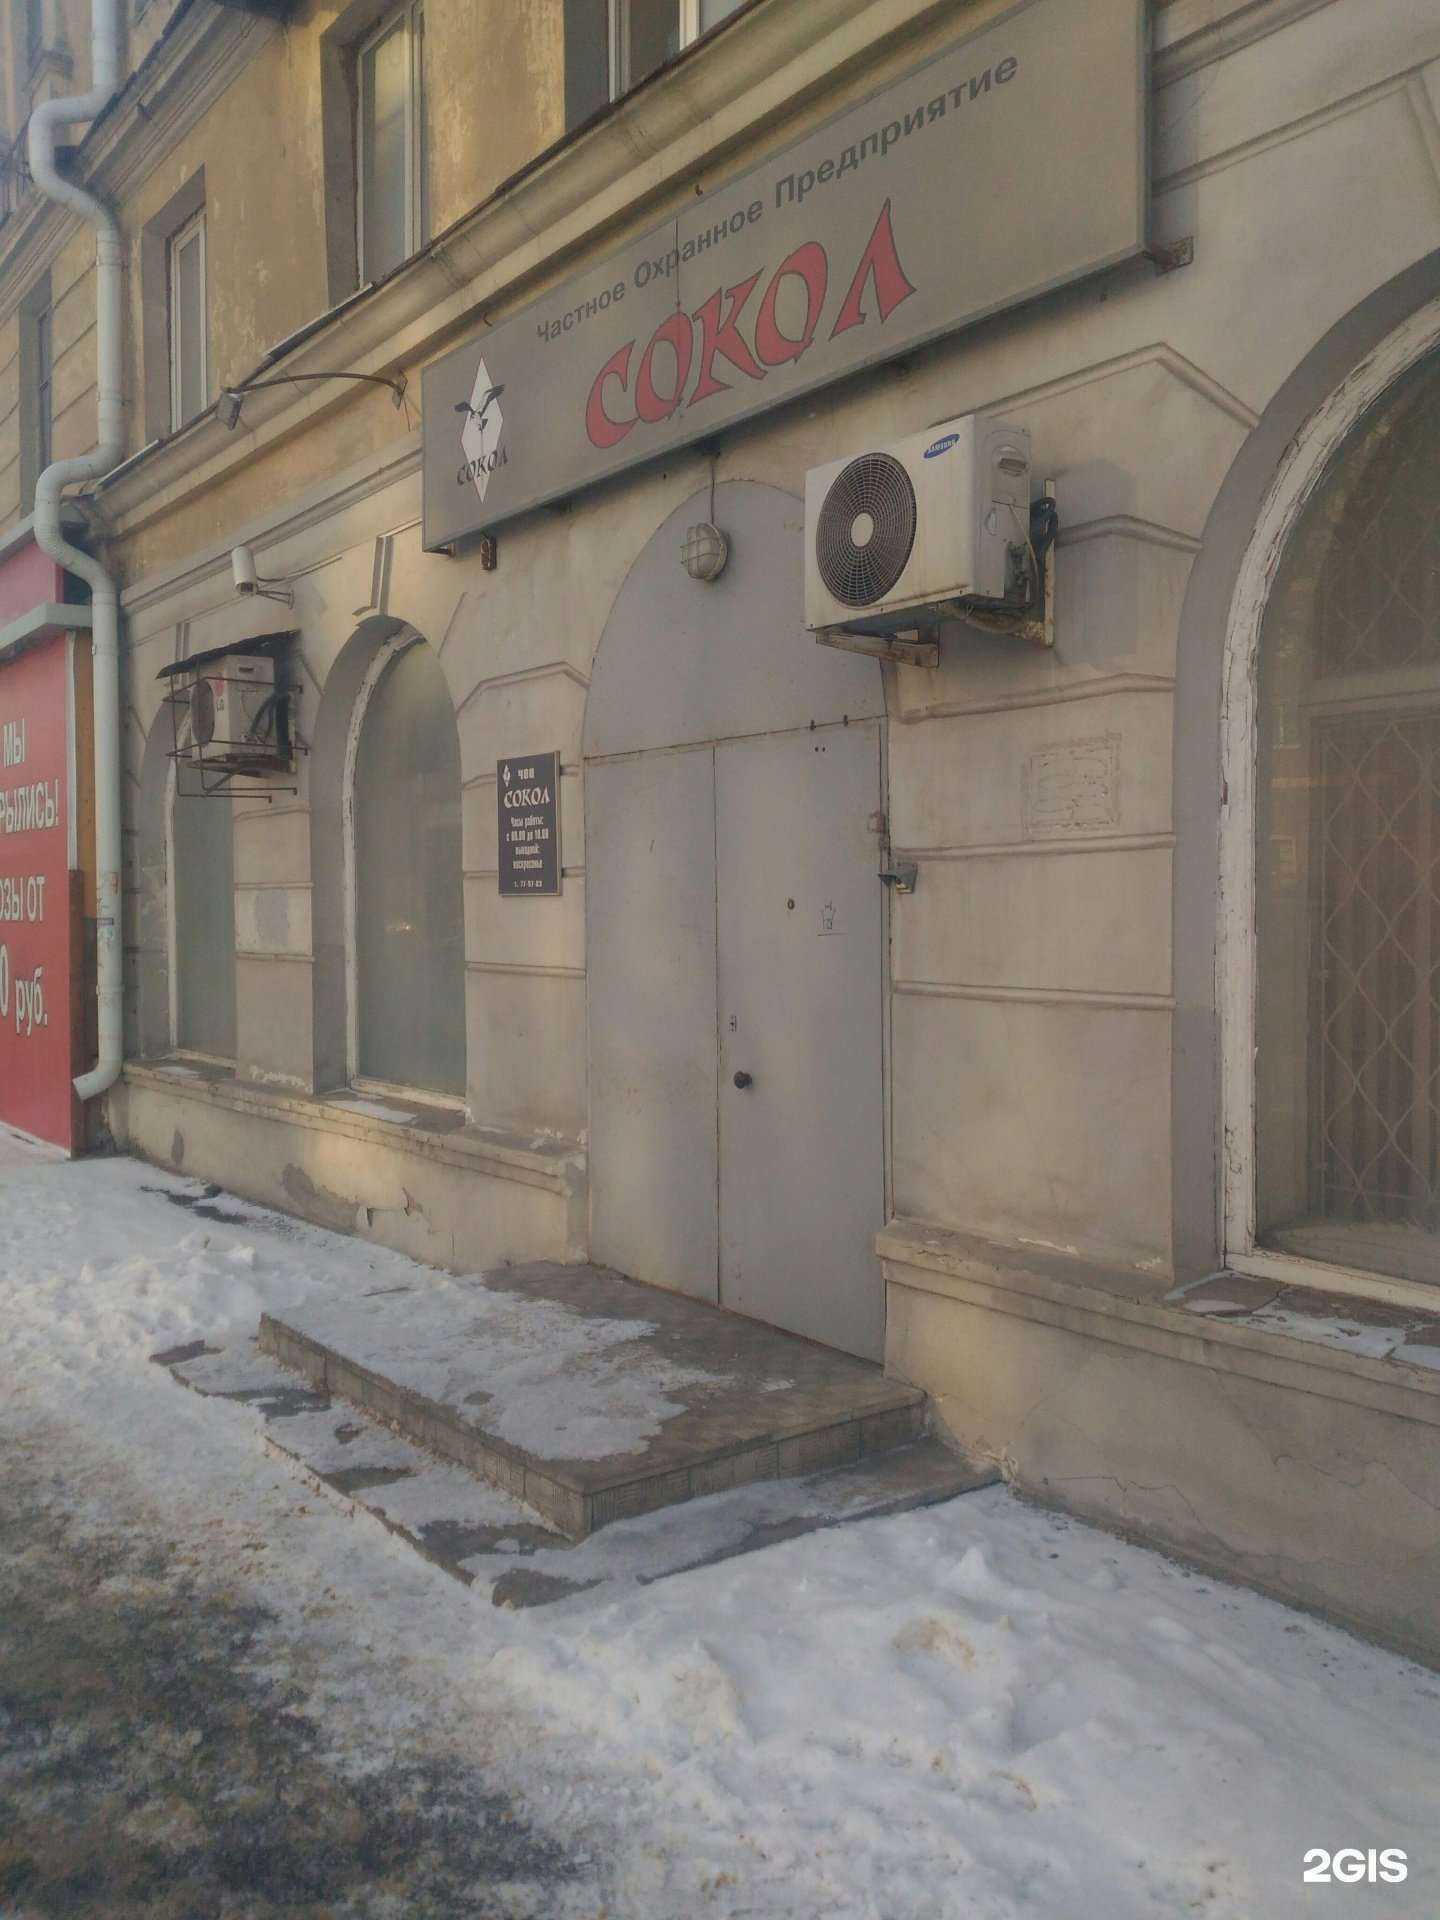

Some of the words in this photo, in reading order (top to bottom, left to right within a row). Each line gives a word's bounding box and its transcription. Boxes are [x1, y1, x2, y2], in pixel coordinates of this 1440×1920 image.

[536, 281, 626, 342] Частное
[633, 200, 763, 289] Охранное
[775, 56, 1018, 208] Предприятие
[585, 197, 917, 449] СОКОЛ
[457, 446, 508, 486] СОКОЛ
[3, 717, 25, 768] МЫ
[504, 784, 550, 809] СОКОЛ
[27, 876, 45, 921] ОТ
[15, 966, 48, 1036] руб.
